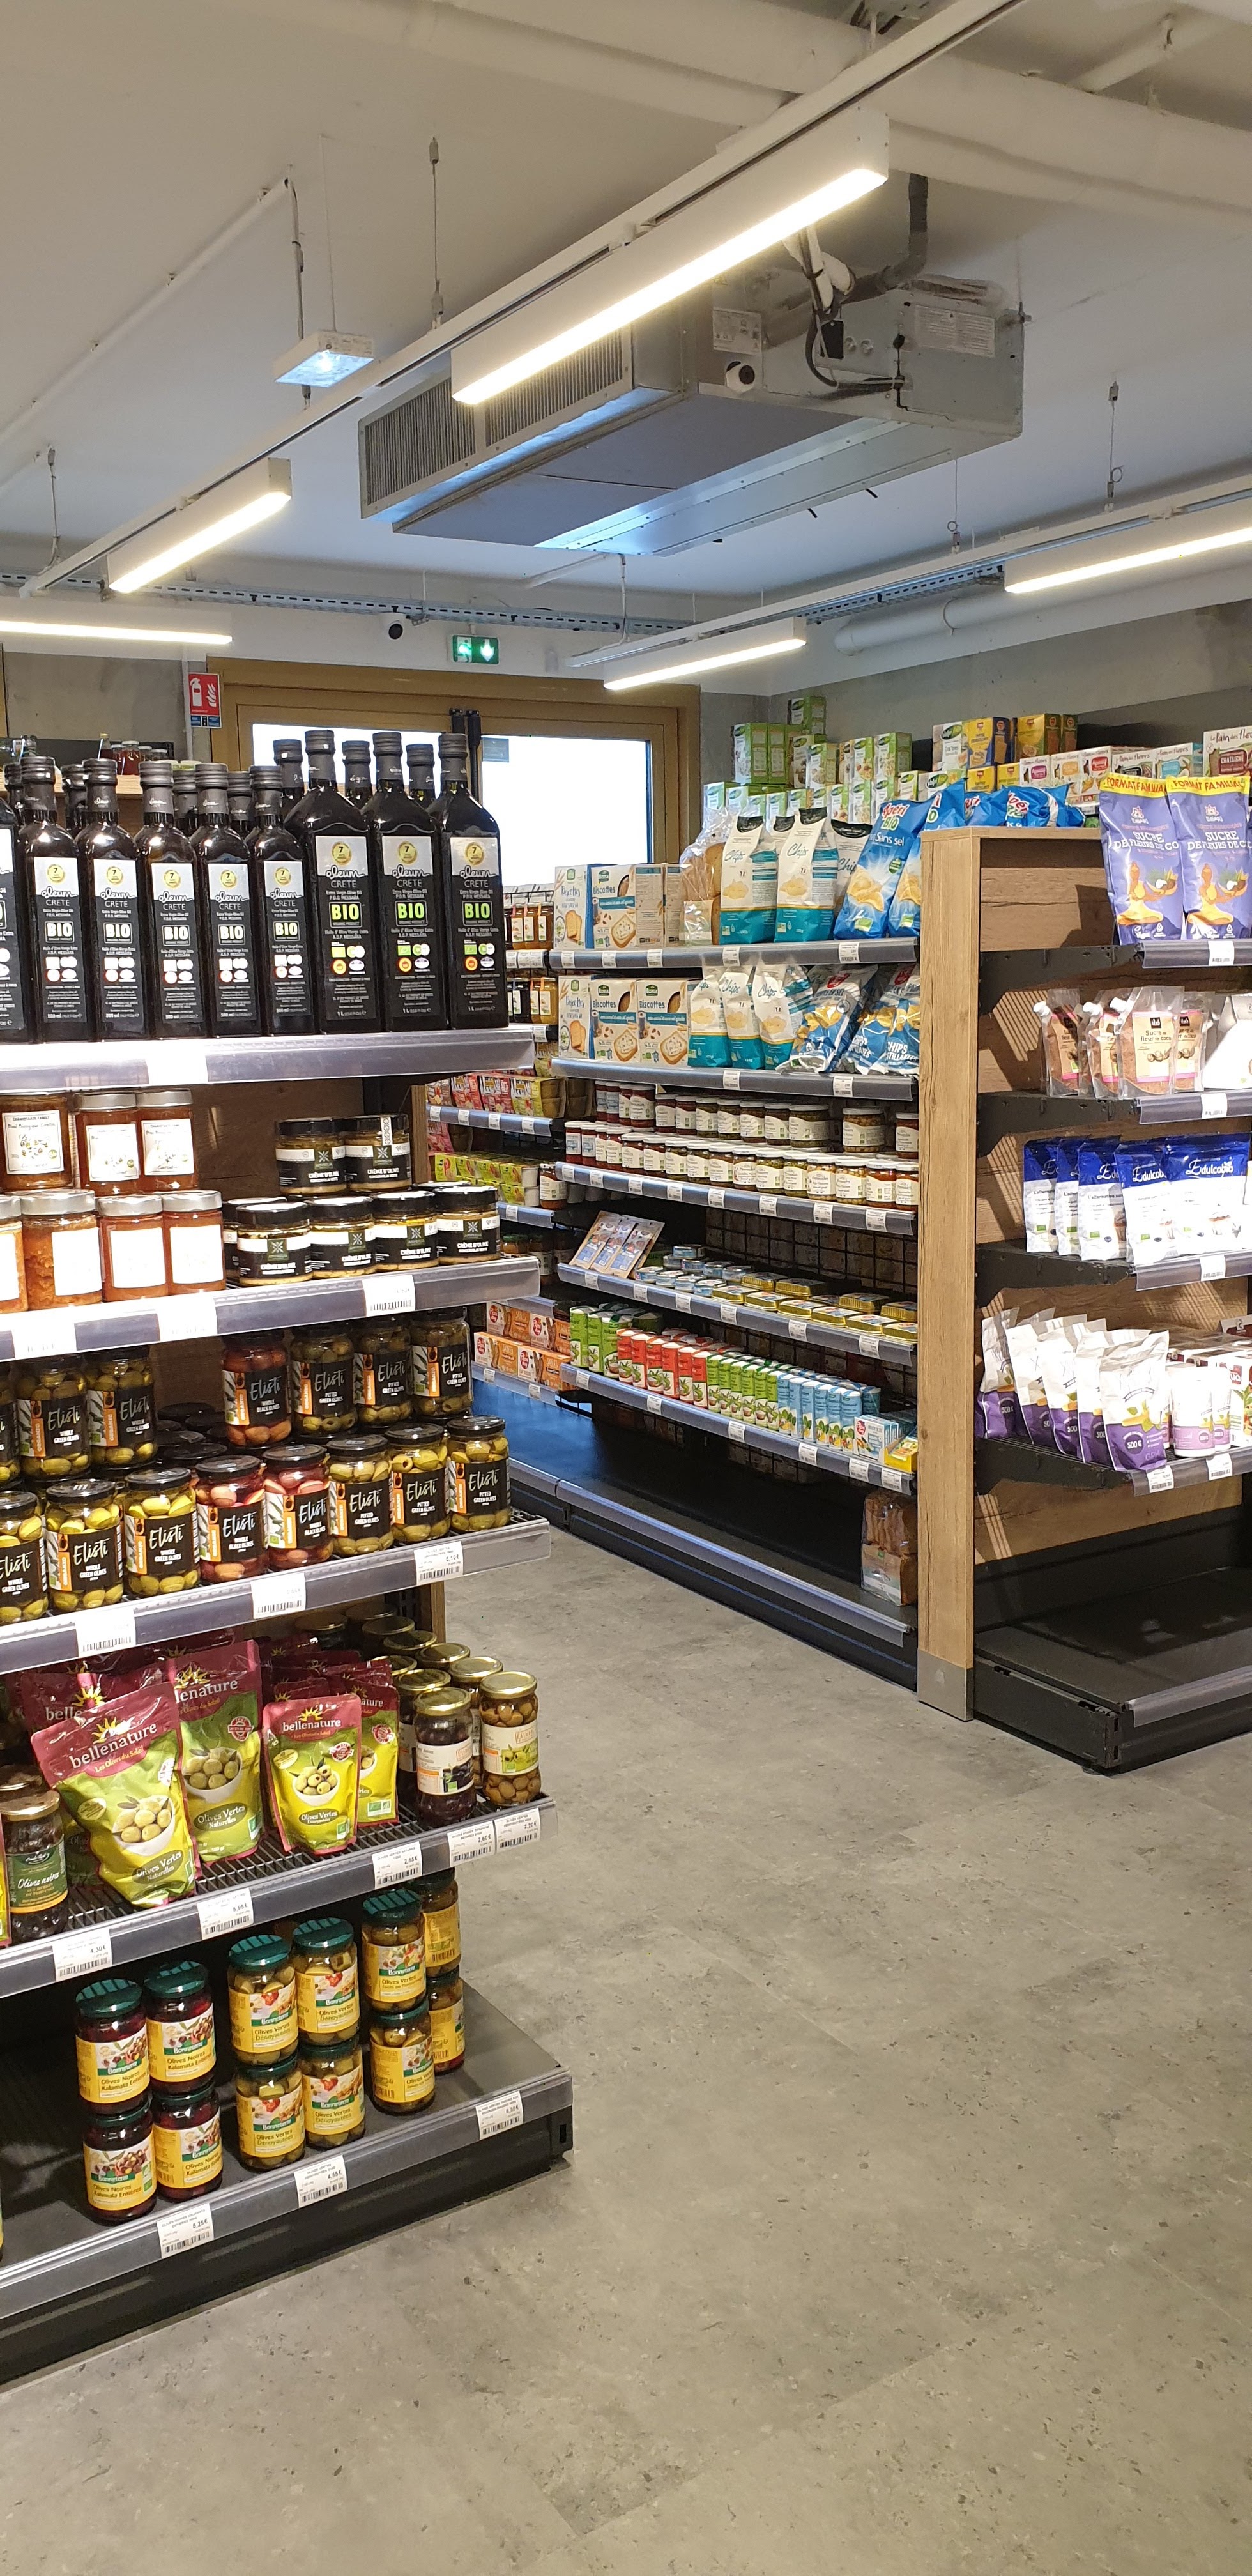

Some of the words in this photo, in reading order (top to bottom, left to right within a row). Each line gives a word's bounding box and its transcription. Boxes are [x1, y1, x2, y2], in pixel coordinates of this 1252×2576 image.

[1107, 776, 1136, 790] FORMAT
[1173, 780, 1202, 791] FORMAT
[883, 816, 899, 830] BIO
[894, 836, 905, 846] sel
[1133, 831, 1164, 843] SUCRE
[1205, 831, 1239, 841] SUCRE
[1113, 838, 1128, 850] DE
[1187, 841, 1202, 850] DE
[1202, 841, 1227, 850] FLEURS
[1228, 840, 1238, 849] DE
[838, 858, 857, 874] Chip
[332, 904, 359, 921] BIO
[398, 903, 425, 919] BIO
[464, 903, 490, 919] BIO
[47, 923, 72, 937] BIO
[106, 924, 130, 938] BIO
[164, 926, 188, 940] BIO
[220, 926, 243, 940] BIO
[275, 923, 298, 936] BIO
[593, 999, 616, 1008] Biscottes
[639, 1000, 665, 1009] Biscottes
[1186, 1157, 1235, 1177] Edulcobio
[1127, 1441, 1138, 1450] 500
[468, 1469, 500, 1492] Elisti
[406, 1478, 439, 1501] Elisti
[349, 1489, 383, 1513] Elisti
[223, 1511, 257, 1538] Elisti
[149, 1523, 186, 1550] Elisti
[73, 1538, 111, 1565] Elisti
[174, 1680, 238, 1703] lenature
[361, 1698, 384, 1708] ature
[45, 1706, 83, 1721] belle
[283, 1719, 342, 1732] bellenature
[69, 1722, 158, 1769] bellenature
[95, 1765, 105, 1773] Les
[198, 1814, 222, 1823] Olives
[222, 1805, 245, 1818] Vertes
[318, 1811, 337, 1819] Vertes
[208, 1816, 236, 1828] Naturelles
[159, 1851, 182, 1869] Vertes
[17, 1876, 40, 1889] Olives
[40, 1872, 60, 1885] noires
[90, 1944, 107, 1954] 4,30€
[121, 2070, 141, 2082] Noires
[333, 2108, 351, 2117] Vertes
